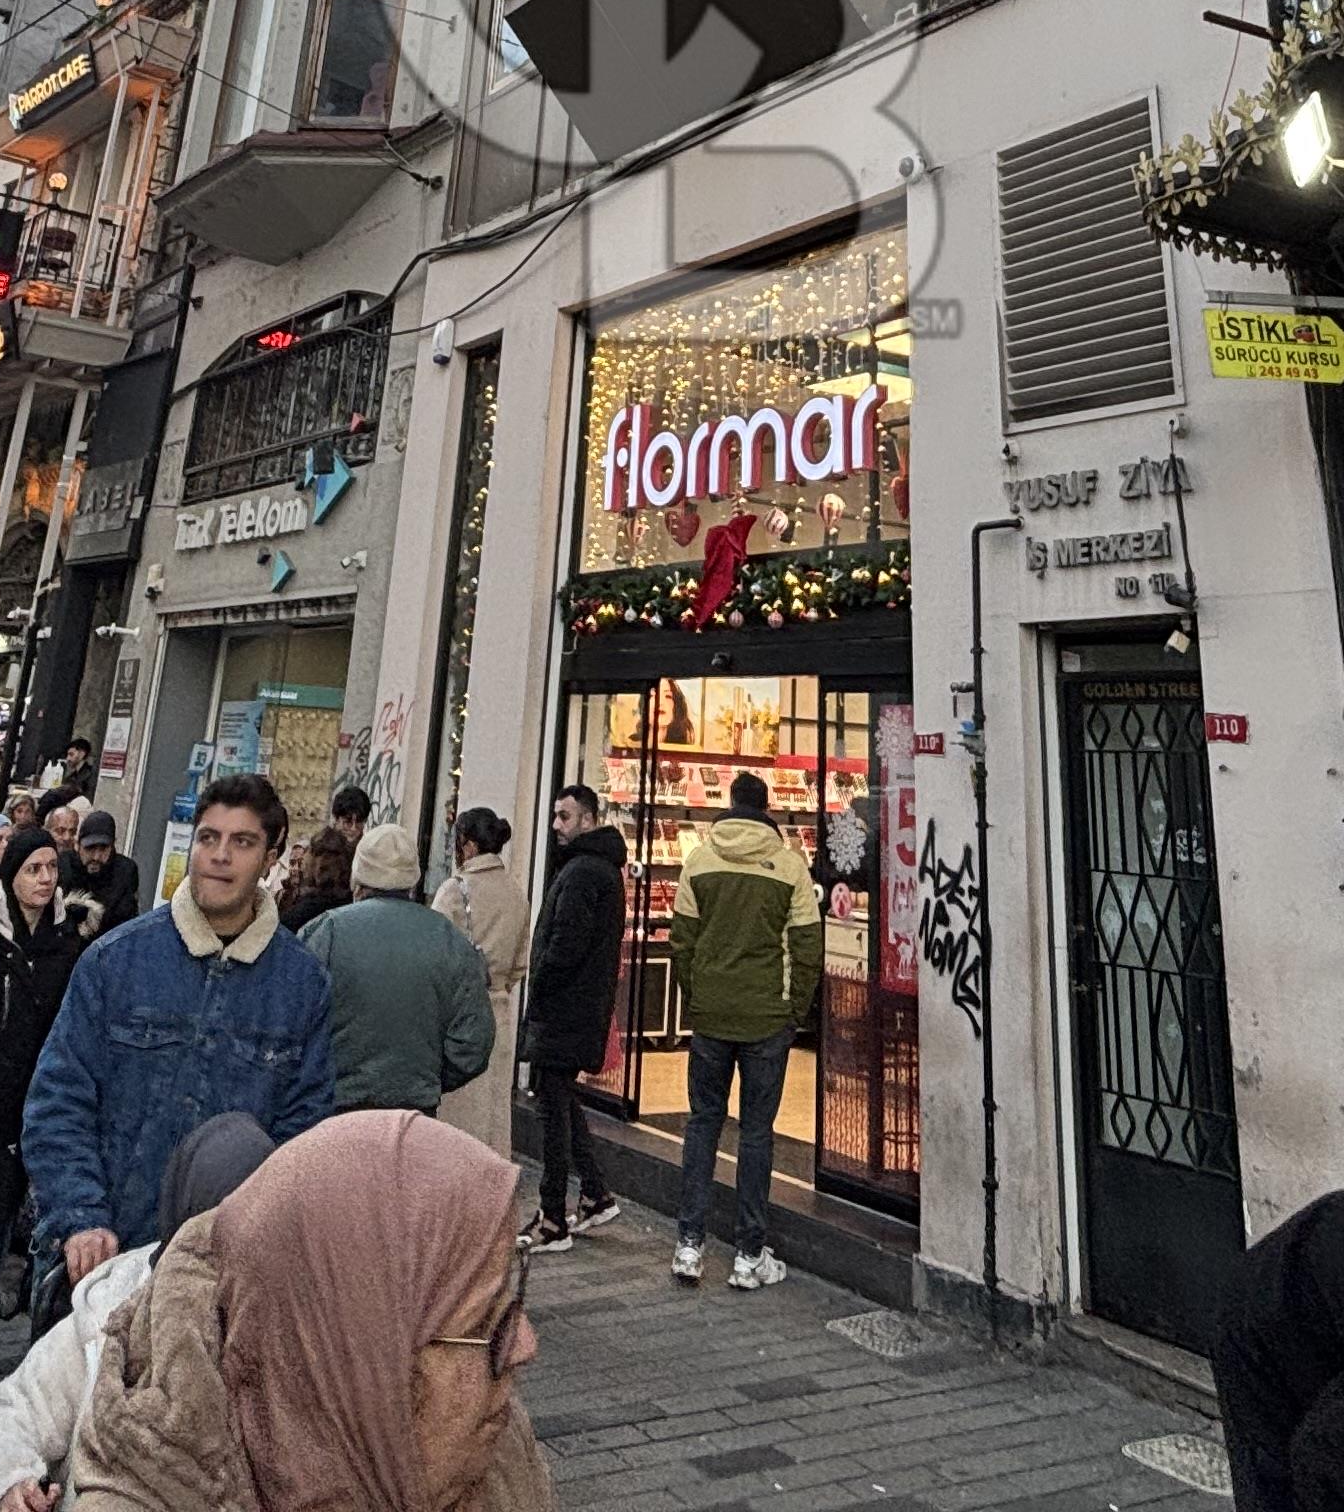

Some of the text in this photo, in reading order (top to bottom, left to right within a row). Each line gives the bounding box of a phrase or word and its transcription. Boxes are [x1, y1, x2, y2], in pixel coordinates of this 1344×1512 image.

[17, 53, 92, 115] PARROT CAFE
[1215, 345, 1340, 366] SÜRÜCÜ KURSU
[1260, 365, 1319, 379] 243 49 43
[604, 386, 887, 512] flormar
[1004, 469, 1099, 514] YUSUF
[1054, 521, 1172, 568] MERKEZİ
[1115, 576, 1140, 597] NO
[1149, 682, 1200, 697] STREE
[1215, 718, 1239, 735] 110
